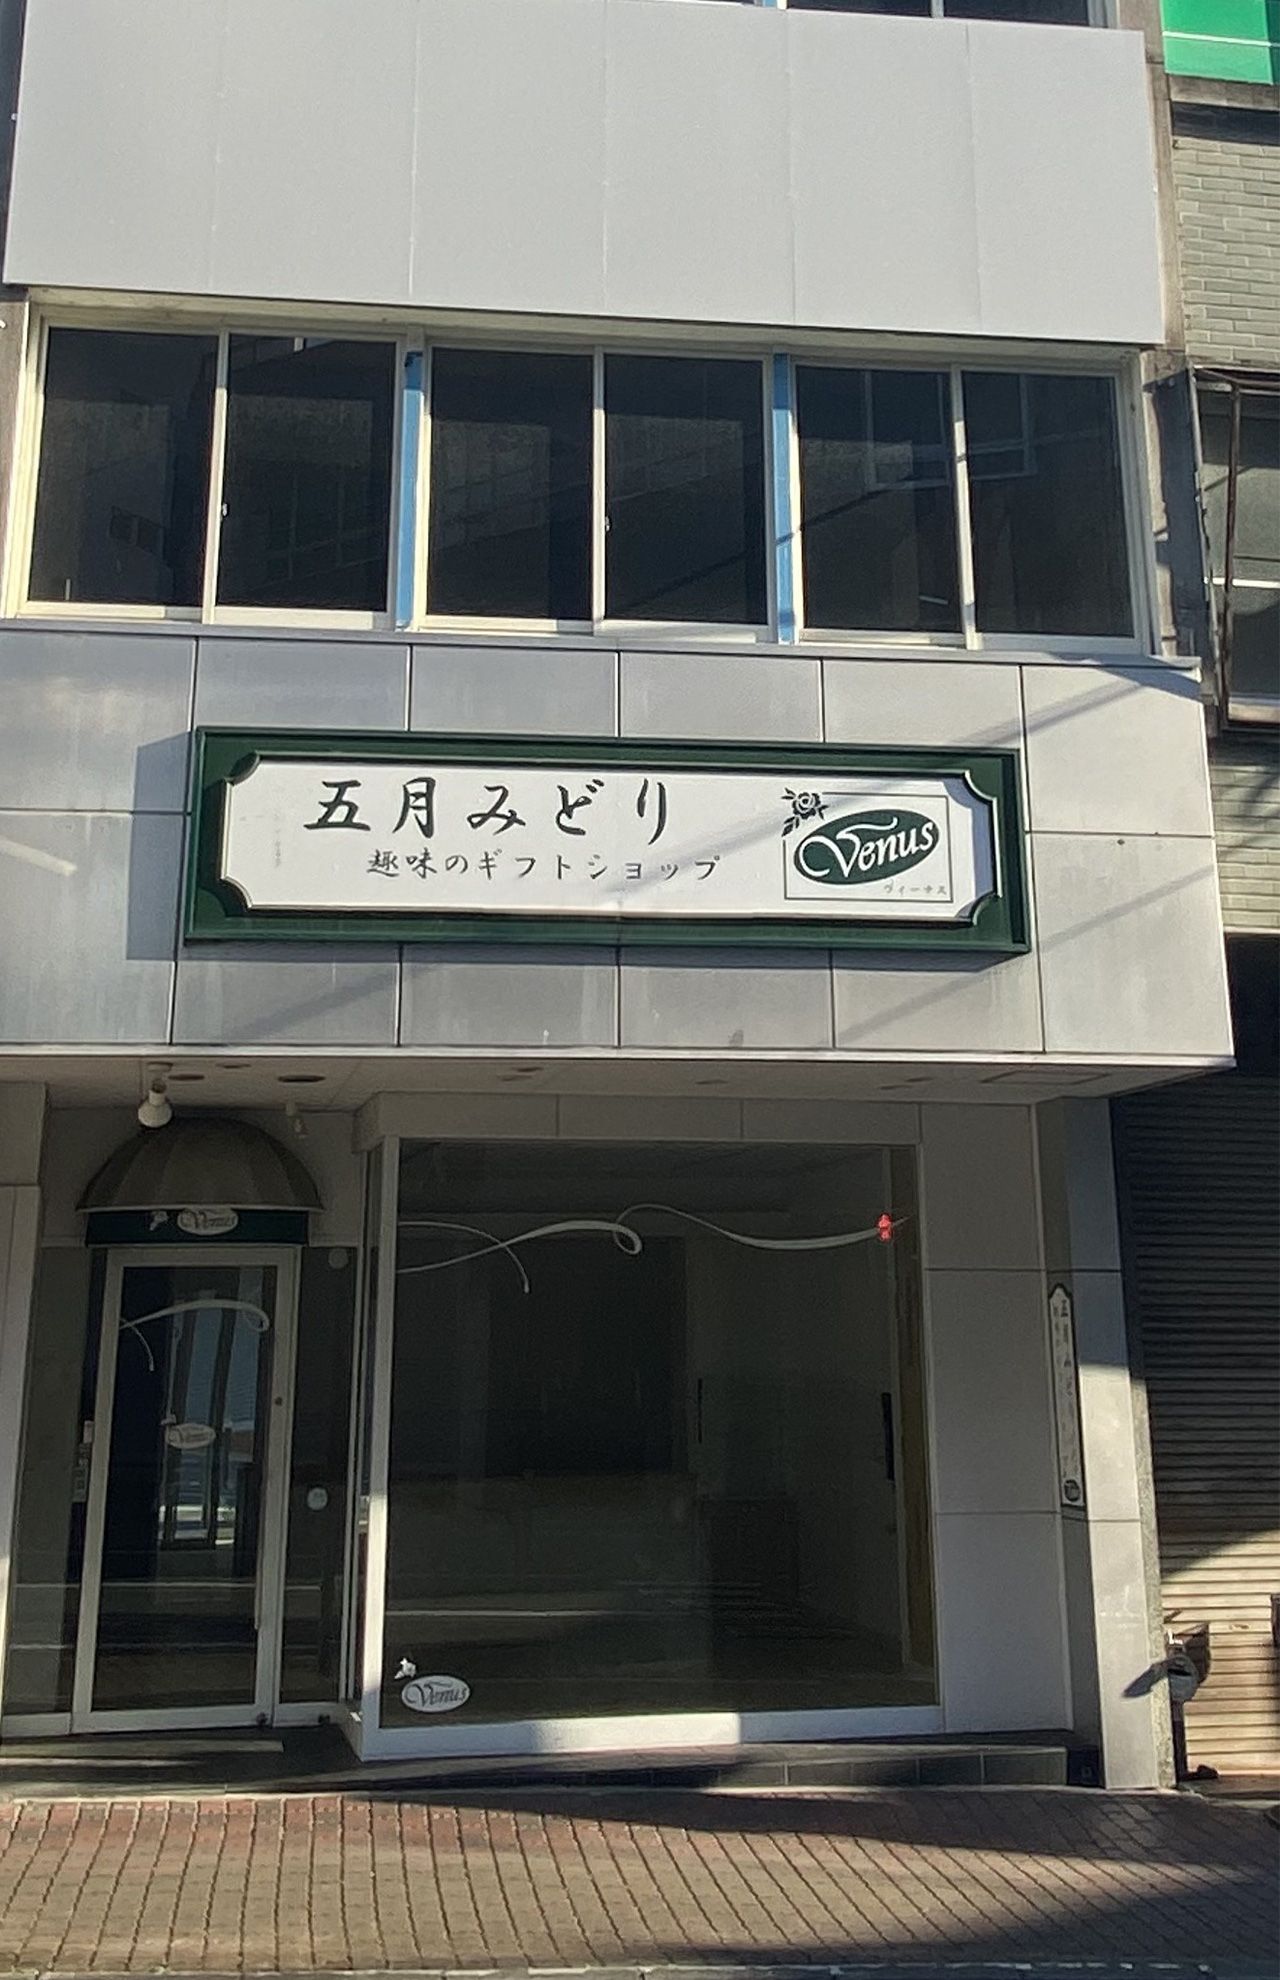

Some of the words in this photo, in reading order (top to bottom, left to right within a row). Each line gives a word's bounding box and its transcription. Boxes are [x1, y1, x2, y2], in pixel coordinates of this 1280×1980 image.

[303, 777, 667, 845] 五月みどり
[366, 848, 720, 880] 趣味のギフトショップ
[799, 817, 934, 878] Venus
[405, 1681, 467, 1707] Venus
